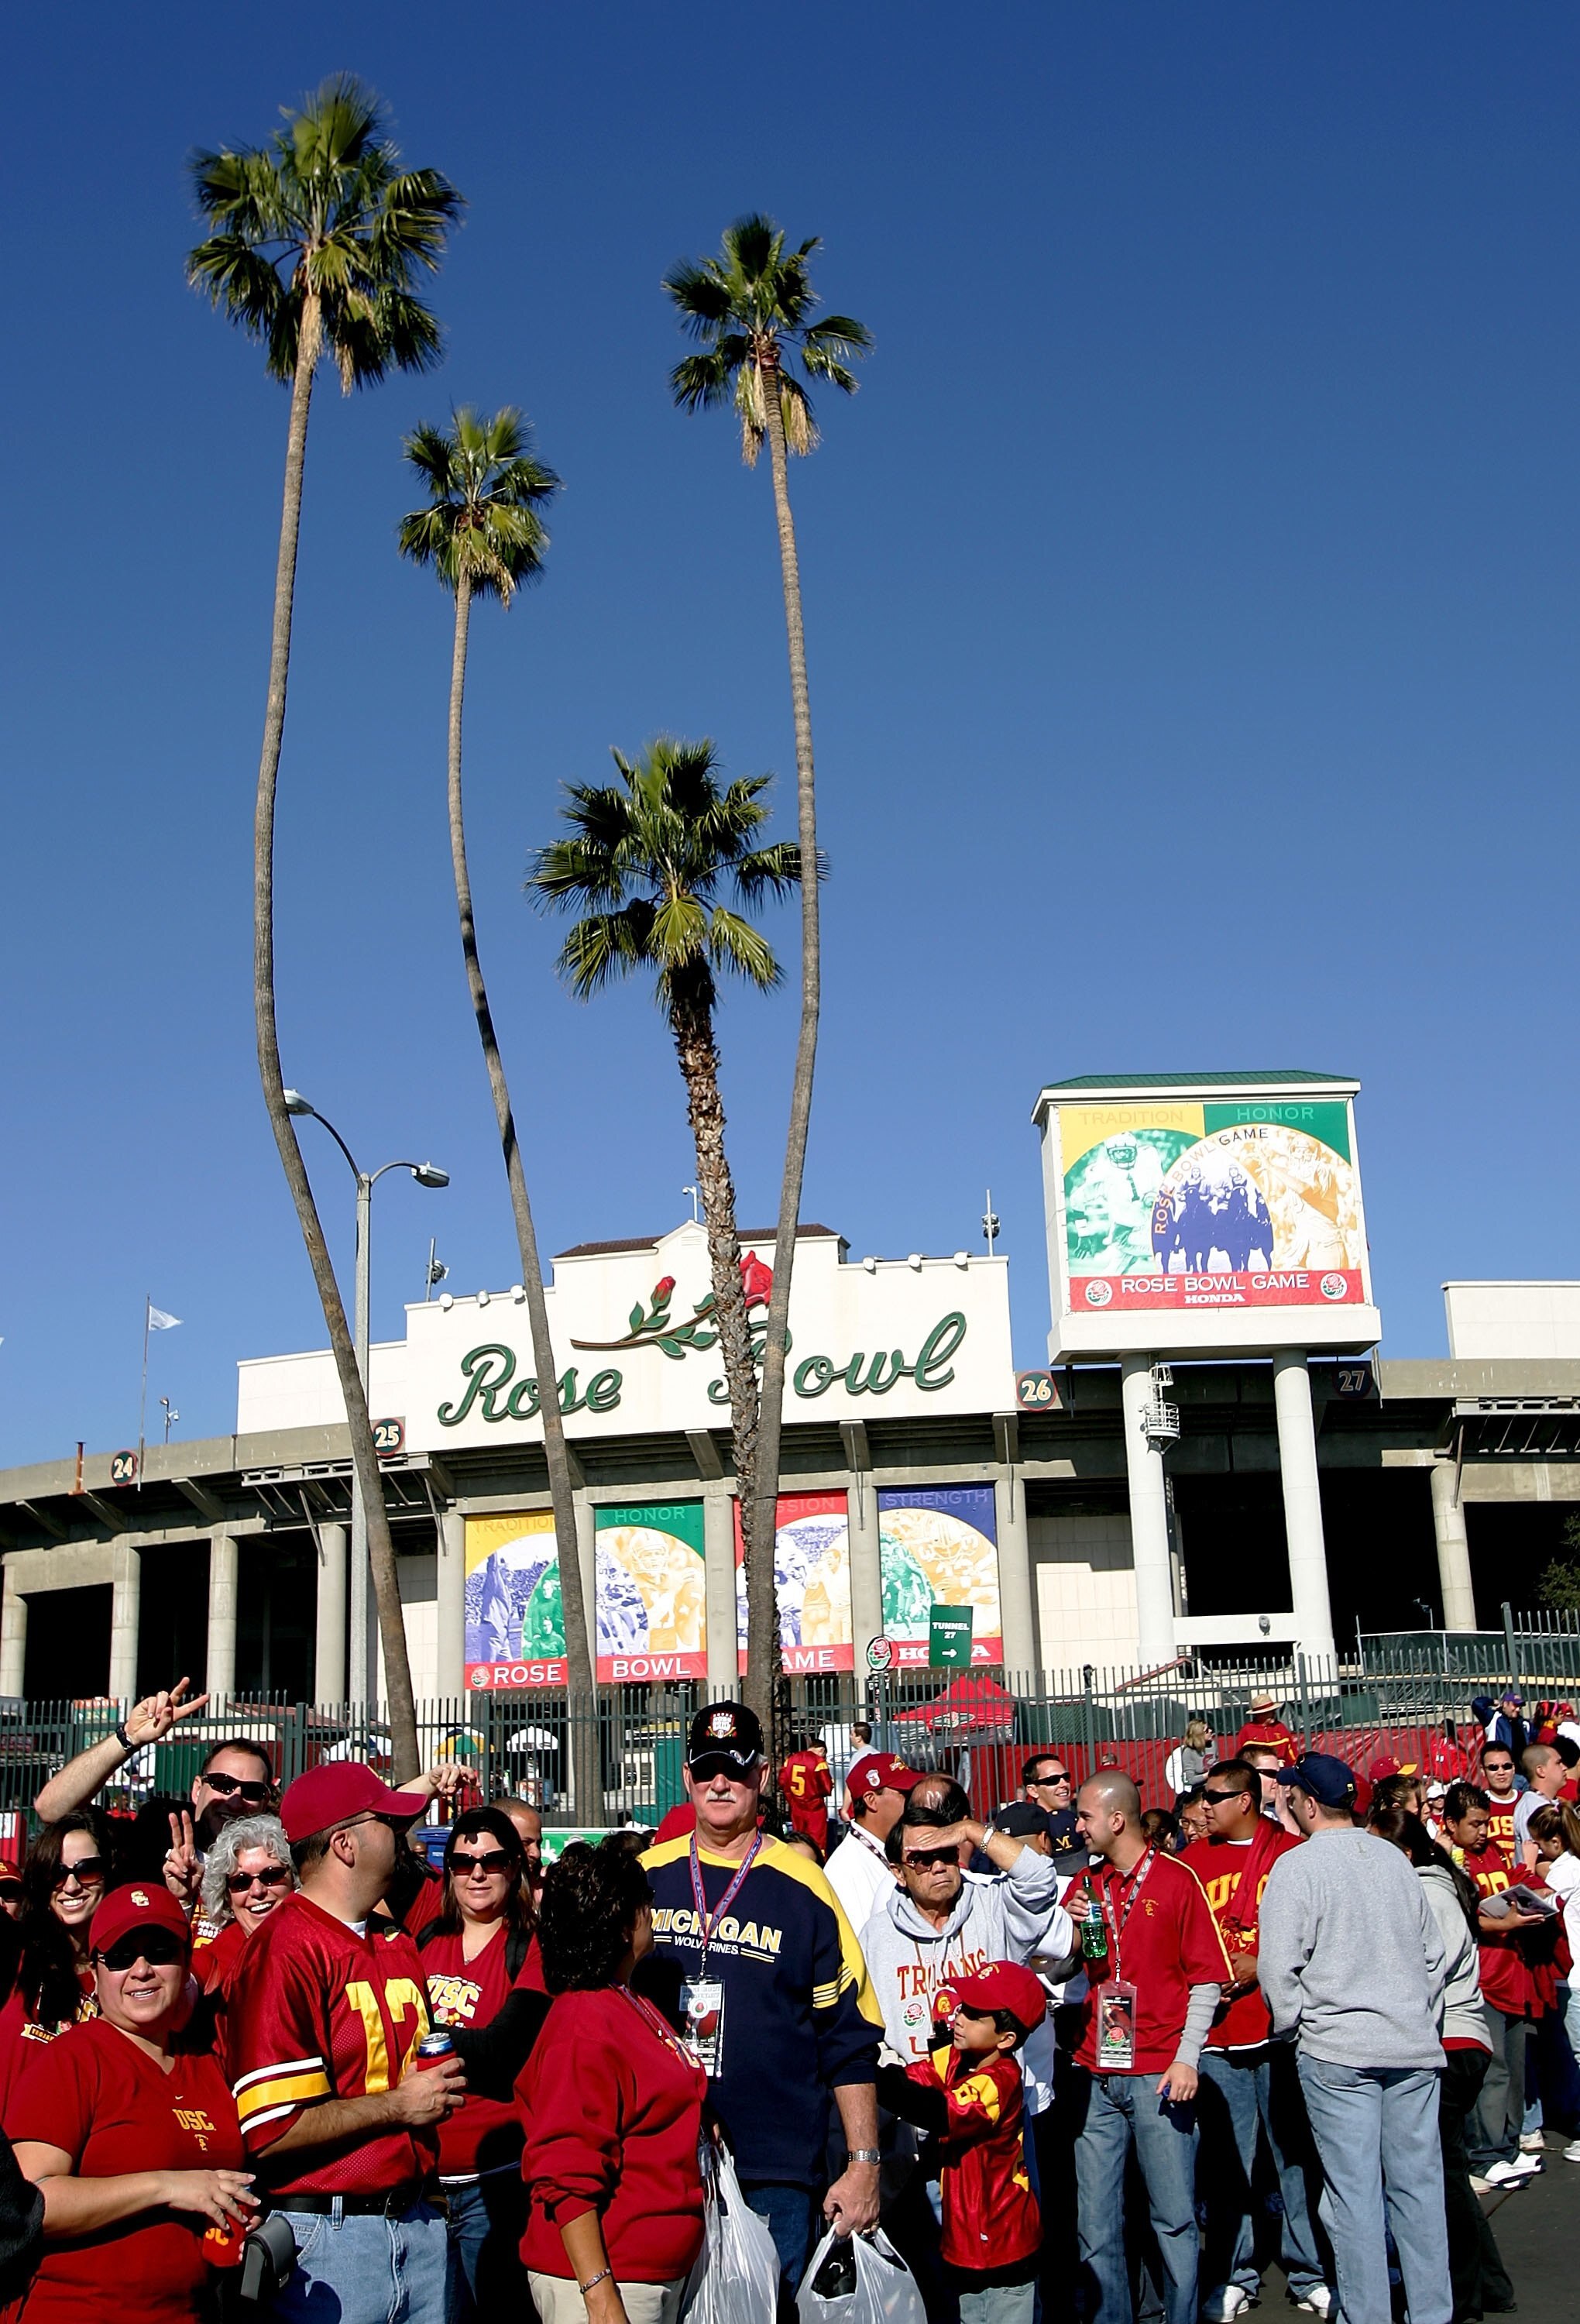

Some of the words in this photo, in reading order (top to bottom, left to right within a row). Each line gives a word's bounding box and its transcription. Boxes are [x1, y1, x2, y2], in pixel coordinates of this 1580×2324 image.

[1077, 1110, 1183, 1126] TRADITION
[1236, 1106, 1315, 1121] HONOR
[1154, 1188, 1176, 1234] ROSE
[1172, 1145, 1216, 1182] BOWL
[1218, 1128, 1269, 1146] GAME
[1121, 1277, 1178, 1294] ROSE
[1184, 1276, 1246, 1291] BOWL
[1251, 1273, 1310, 1289] GAME
[1183, 1293, 1245, 1304] HONDA
[437, 1343, 623, 1427] Rose
[1021, 1379, 1052, 1401] 26
[1338, 1370, 1365, 1391] 27
[374, 1425, 400, 1447] 25
[113, 1456, 133, 1478] 24
[775, 1498, 836, 1512] SSION
[884, 1489, 988, 1508] STRENGTH
[613, 1507, 686, 1524] HONOR
[932, 1621, 970, 1631] TUNNEL
[943, 1631, 957, 1640] 27
[781, 1649, 835, 1669] AME
[898, 1645, 991, 1661] HOA
[493, 1663, 562, 1685] ROSE
[612, 1657, 692, 1679] BOWL
[790, 1764, 807, 1796] 5
[1487, 1815, 1515, 1838] US
[197, 1928, 218, 1939] 2007
[426, 1978, 480, 2019] USC
[171, 2109, 215, 2131] USC
